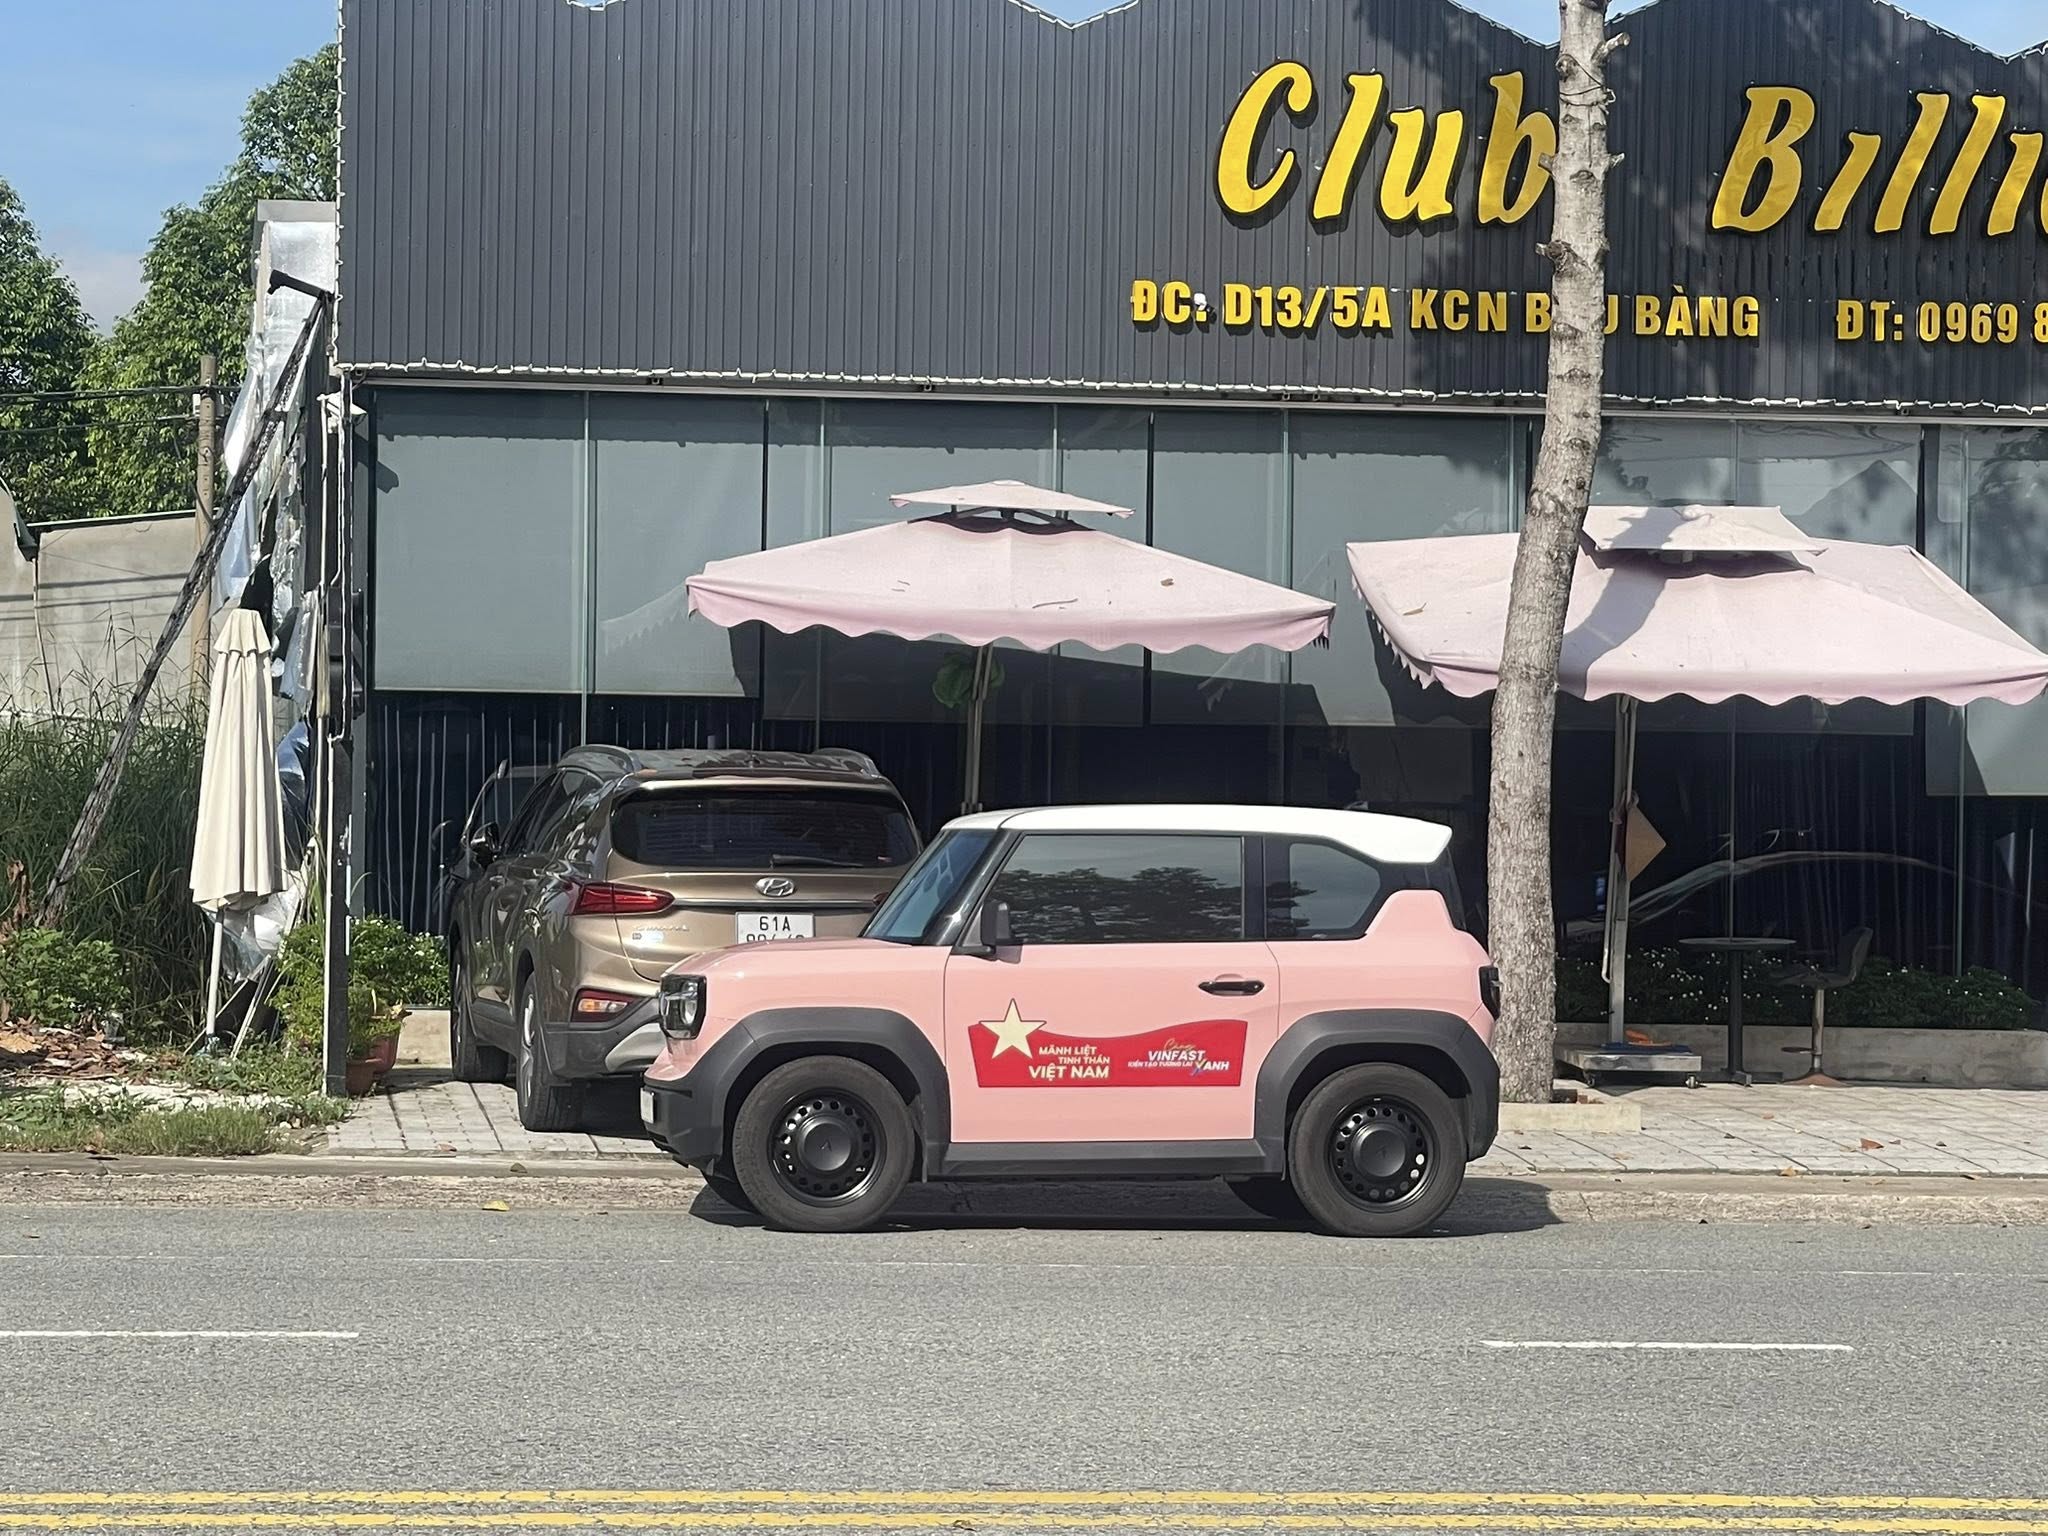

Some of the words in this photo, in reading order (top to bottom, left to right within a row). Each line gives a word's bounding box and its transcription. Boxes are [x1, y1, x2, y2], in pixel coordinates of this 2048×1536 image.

[1217, 61, 1557, 224] Club
[1222, 283, 1392, 329] D13/5A
[1411, 288, 1508, 332] KCN
[1525, 291, 1619, 335] BU
[1635, 284, 1759, 337] BÀNG
[1836, 299, 1903, 342] ĐT:
[1918, 301, 2019, 344] 0969
[759, 915, 791, 932] 61A
[1058, 1056, 1082, 1065] TINH
[1148, 1050, 1206, 1061] VINFAST
[1028, 1062, 1067, 1081] VIỆT
[1070, 1065, 1110, 1079] NAM
